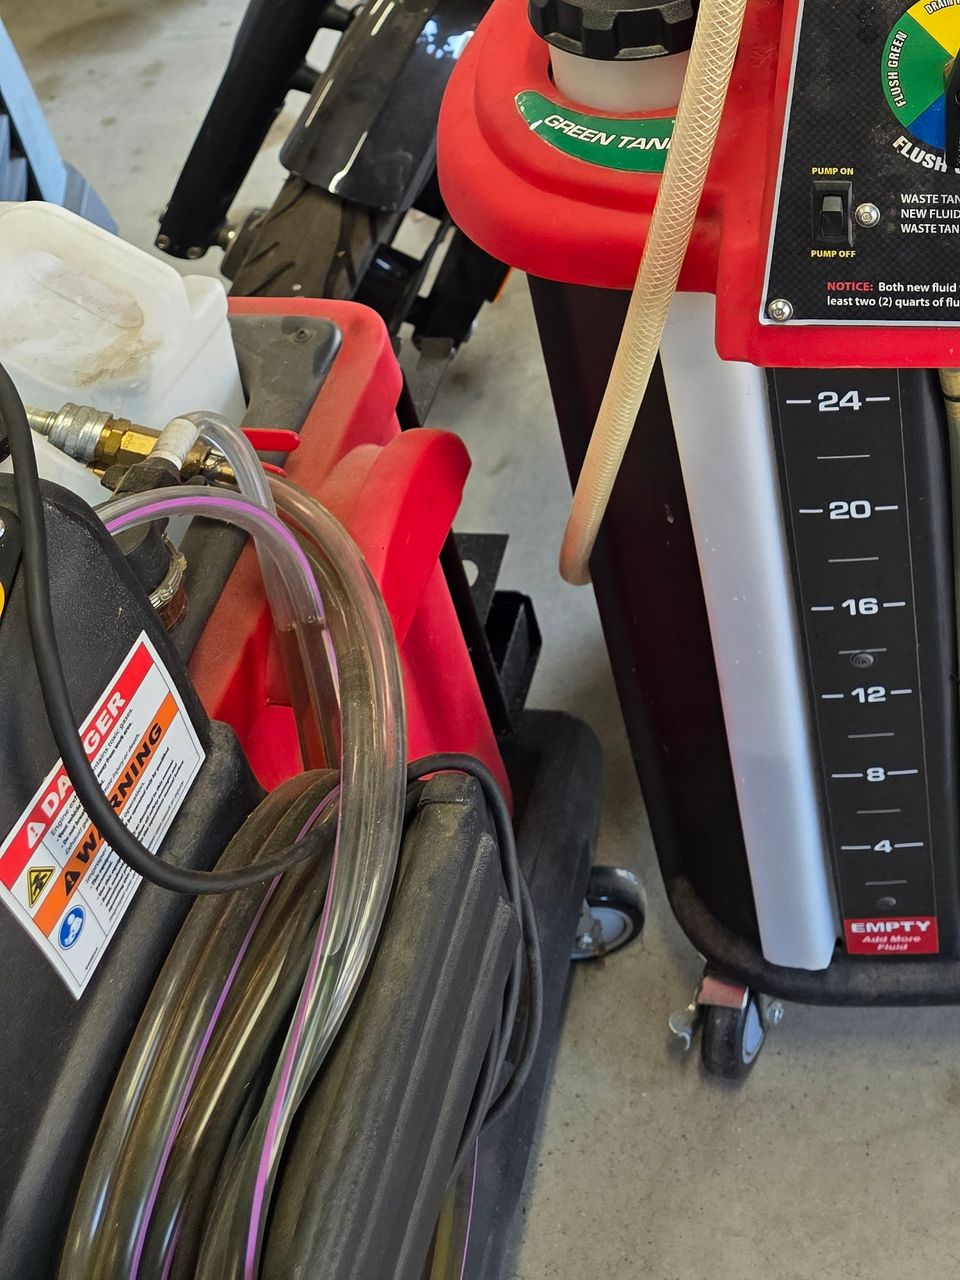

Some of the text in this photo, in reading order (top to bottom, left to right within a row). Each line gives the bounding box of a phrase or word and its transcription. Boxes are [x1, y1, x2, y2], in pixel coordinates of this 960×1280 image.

[887, 31, 908, 107] FLUSH GREEN
[544, 115, 674, 150] GREEN TAN
[892, 135, 948, 173] FLUSH
[901, 194, 938, 204] WASTE
[901, 209, 927, 218] NEW
[930, 210, 960, 219] FLUID
[901, 224, 936, 233] WASTE
[827, 282, 873, 291] NOTICE:
[878, 282, 904, 292] Both
[932, 282, 956, 292] fluid
[827, 296, 853, 305] least
[855, 297, 876, 306] two
[878, 297, 892, 307] (2)
[895, 298, 930, 308] quarts
[932, 298, 943, 307] of
[817, 390, 862, 412] 24
[828, 500, 872, 519] 20
[841, 597, 879, 615] 16
[850, 686, 887, 703] 12
[40, 690, 127, 821] DAGER
[866, 767, 886, 782] 8
[874, 839, 893, 853] 4
[851, 921, 931, 933] EMPTY
